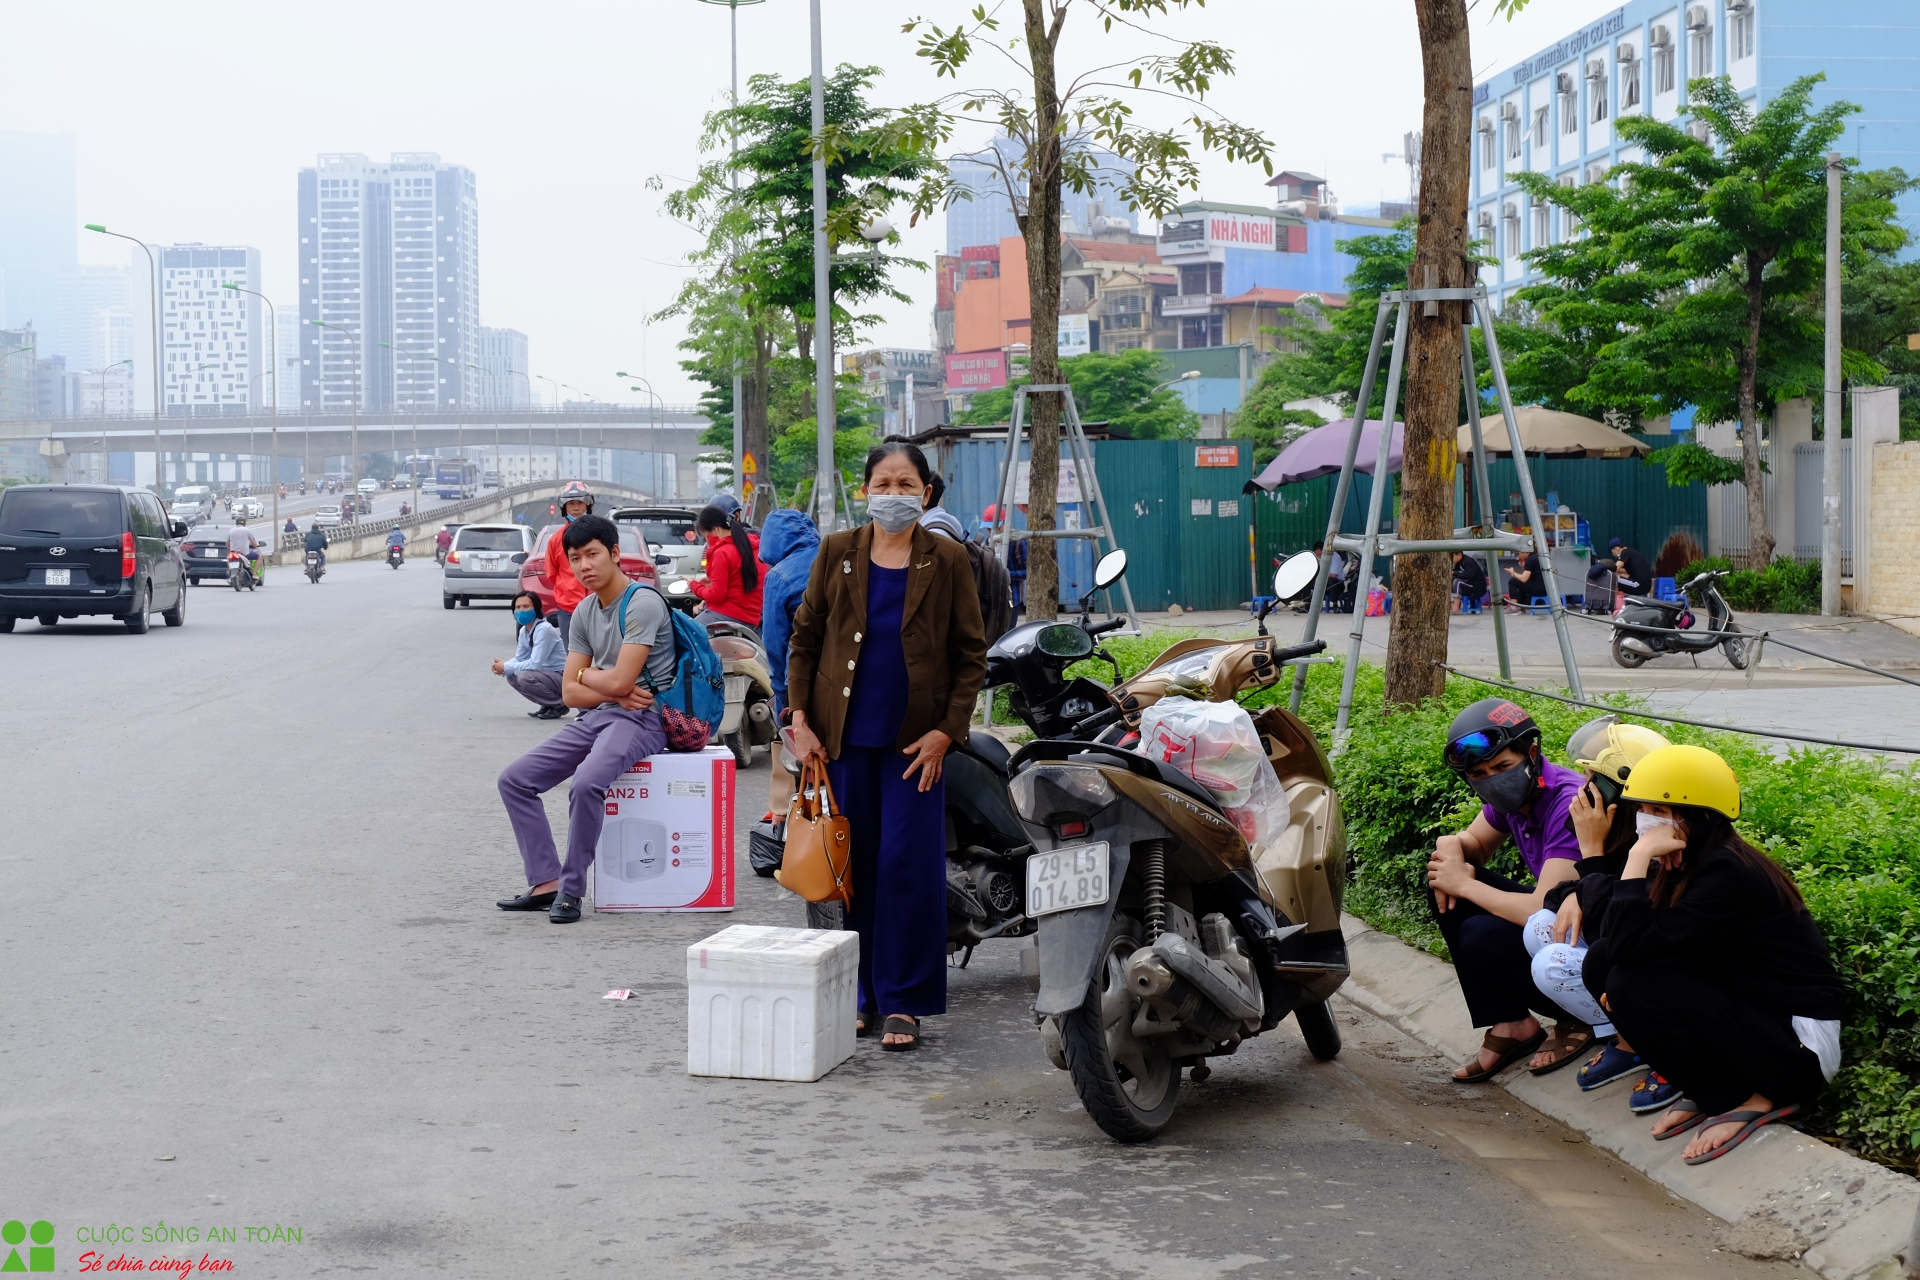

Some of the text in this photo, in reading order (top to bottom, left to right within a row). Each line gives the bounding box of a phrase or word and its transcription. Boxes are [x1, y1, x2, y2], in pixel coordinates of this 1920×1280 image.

[390, 163, 436, 172] BONANZA
[1211, 216, 1273, 245] NHÀ NGHỈ
[640, 788, 649, 798] B
[1038, 847, 1097, 882] 29-L5
[1032, 875, 1103, 911] 014.89
